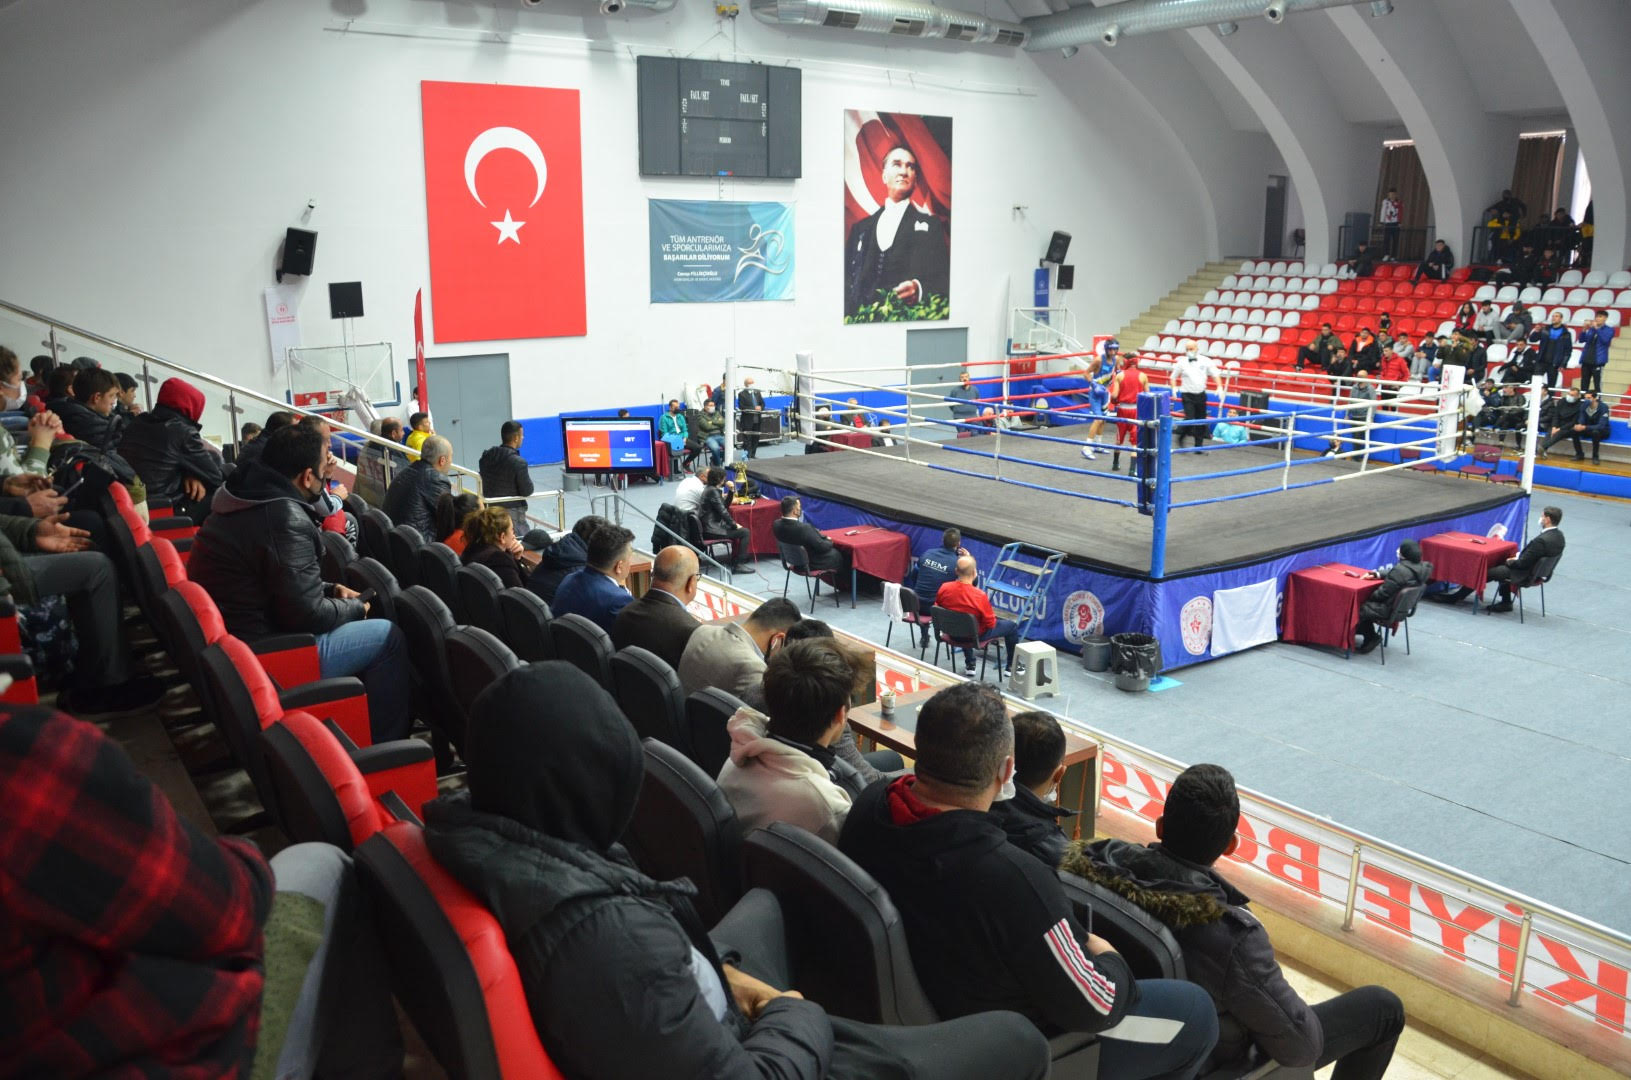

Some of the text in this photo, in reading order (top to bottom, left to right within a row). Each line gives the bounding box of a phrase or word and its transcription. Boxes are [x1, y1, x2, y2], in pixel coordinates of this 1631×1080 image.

[671, 235, 685, 243] TÜM
[672, 244, 731, 252] SPORCULARIMIZA
[663, 253, 697, 262] BAŞARILAR
[924, 558, 948, 572] SEM
